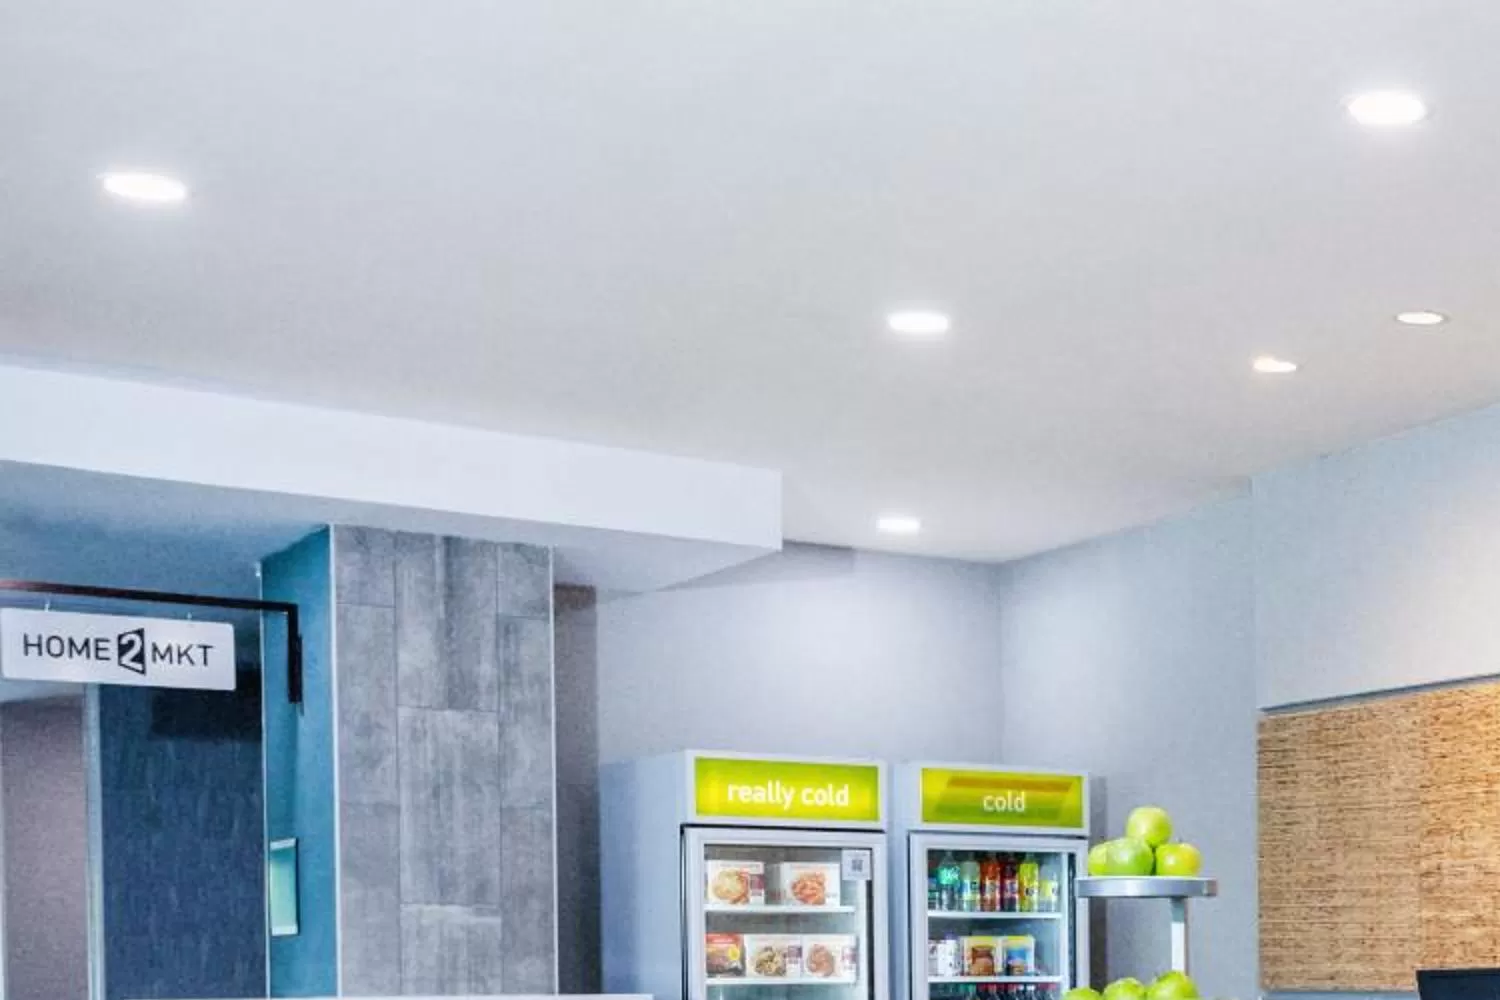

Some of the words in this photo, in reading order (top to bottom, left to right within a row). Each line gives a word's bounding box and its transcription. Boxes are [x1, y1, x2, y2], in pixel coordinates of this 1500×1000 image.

[727, 780, 795, 811] really
[801, 783, 850, 807] cold
[982, 791, 1026, 813] cold
